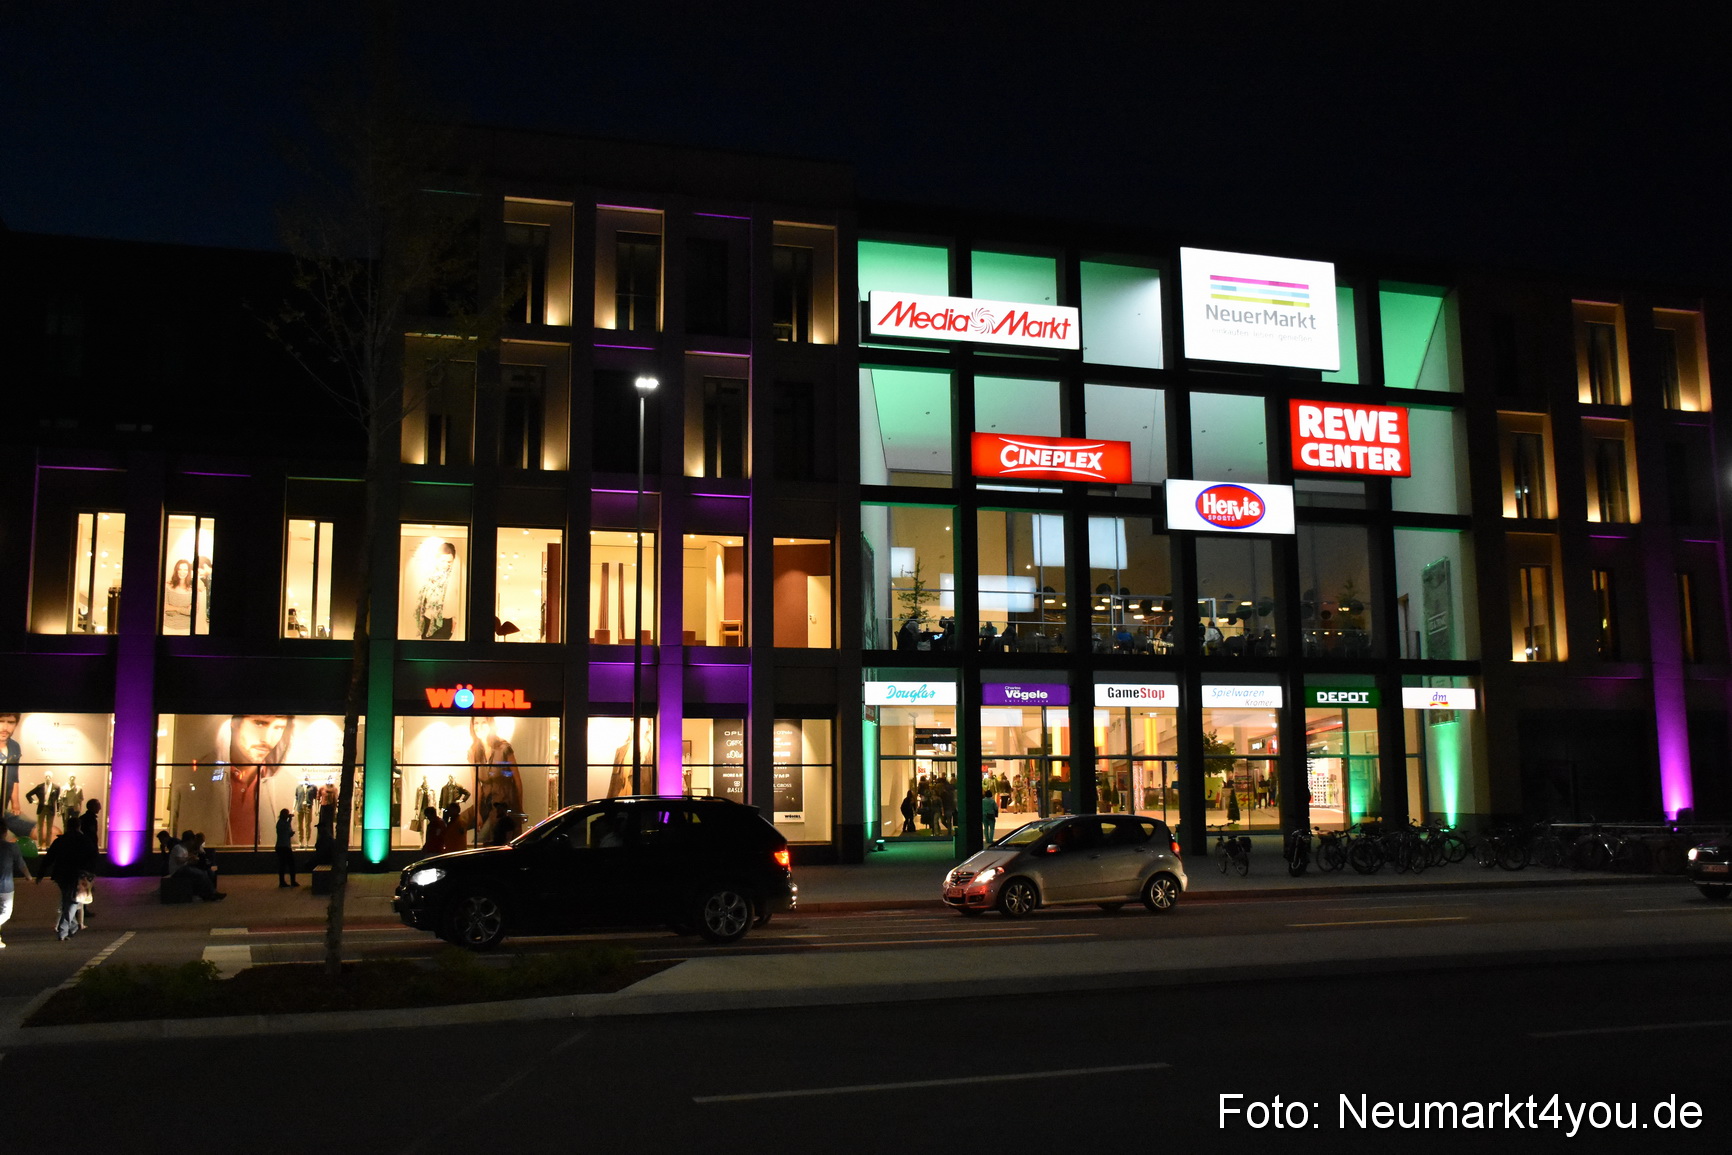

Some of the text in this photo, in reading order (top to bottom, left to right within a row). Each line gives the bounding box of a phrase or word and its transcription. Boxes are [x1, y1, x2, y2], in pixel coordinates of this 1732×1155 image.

[877, 300, 1071, 341] Media Markt
[1205, 303, 1317, 330] NeuerMarkt
[1299, 405, 1401, 443] REWE
[1000, 444, 1104, 471] CINEPLEX
[1300, 443, 1402, 473] CENTER
[1202, 493, 1261, 520] Hervis
[425, 683, 532, 709] WÖHRL
[886, 684, 936, 703] Douglas
[1004, 689, 1049, 701] Vögele
[1107, 686, 1165, 701] GameStop
[1211, 687, 1265, 699] Spielwaren
[1316, 690, 1369, 704] DEPOT
[1432, 691, 1447, 702] dm
